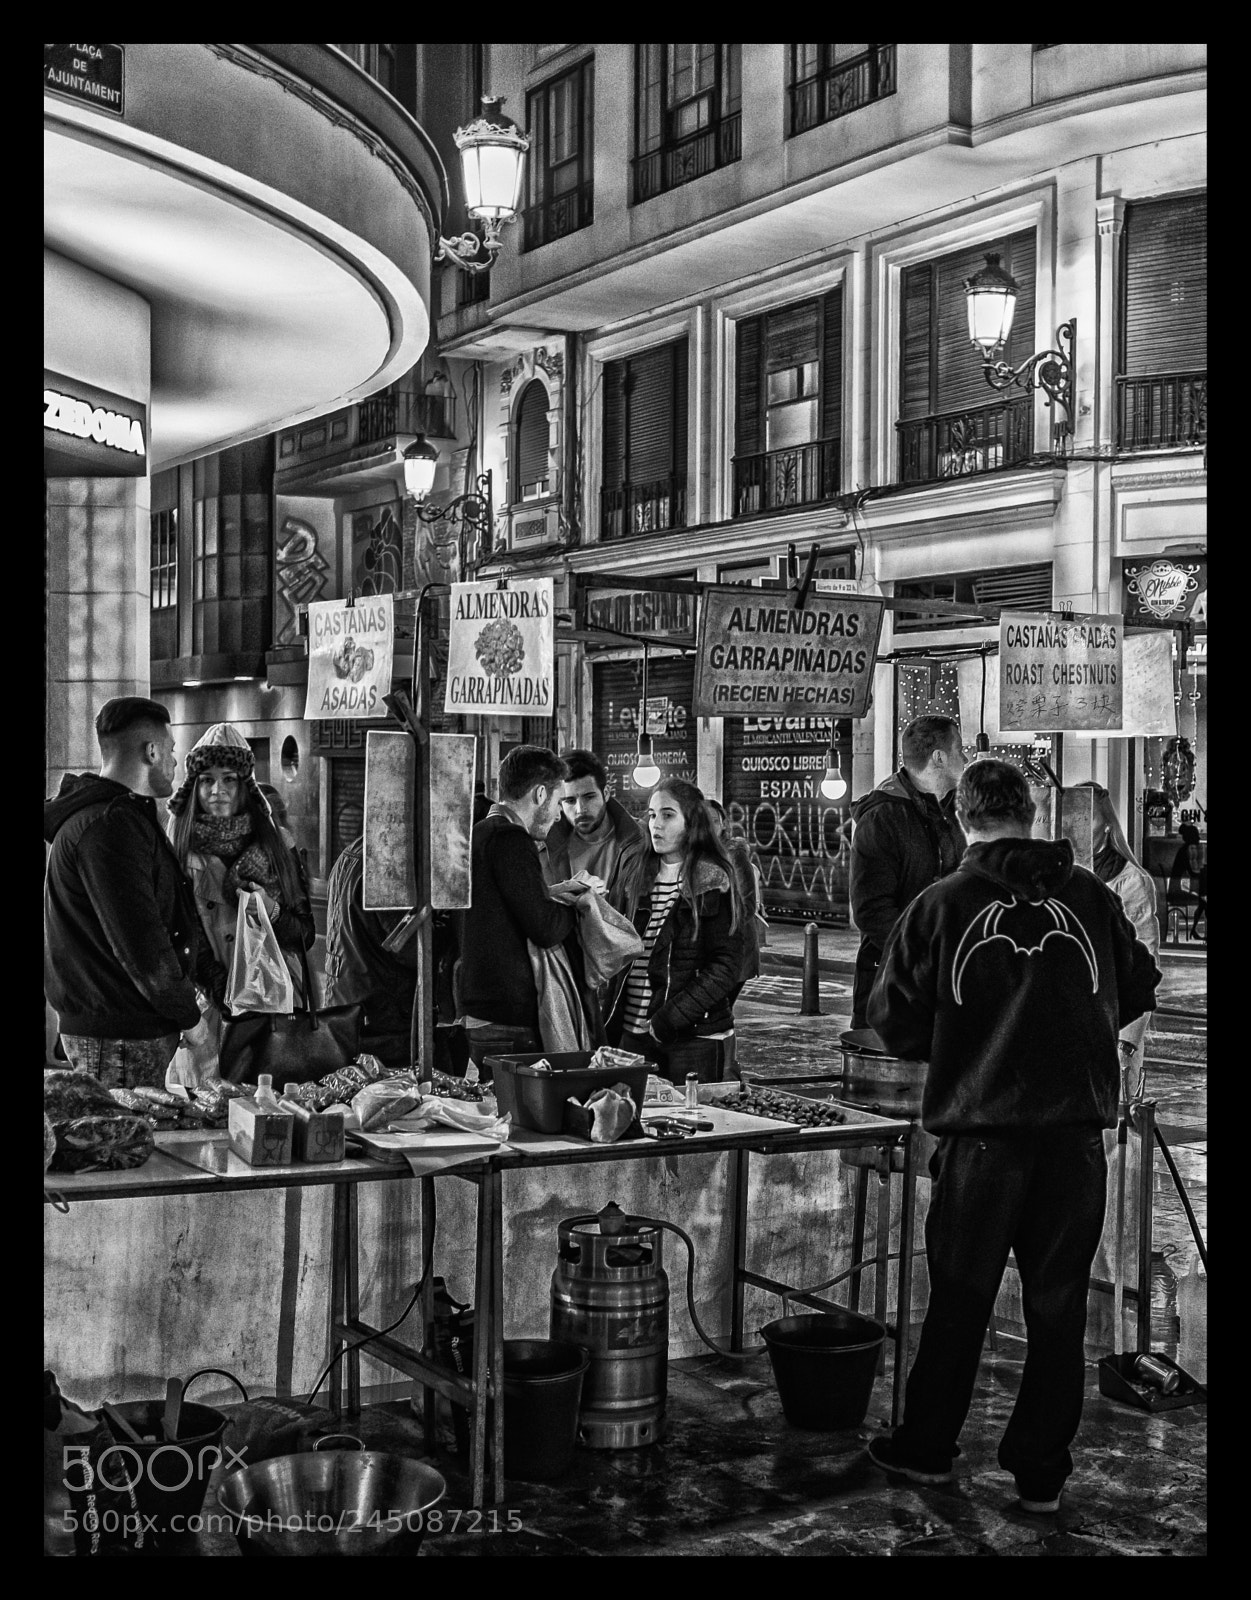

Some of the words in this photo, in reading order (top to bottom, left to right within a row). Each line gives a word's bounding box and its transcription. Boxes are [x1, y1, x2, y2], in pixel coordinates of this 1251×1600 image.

[73, 58, 87, 72] DE
[455, 590, 549, 620] ALMENDRAS
[315, 603, 386, 637] CASTAÑAS
[727, 607, 859, 637] ALMENDRAS
[1007, 621, 1067, 648] CASTAÑAS
[1072, 626, 1116, 649] SADAS
[709, 642, 867, 674] GARRAPIÑADAS
[1006, 664, 1044, 685] ROAST
[1053, 664, 1117, 685] CHESTNUTS
[320, 685, 378, 711] ASADAS
[712, 685, 780, 704] (RECIEN
[783, 687, 855, 707] HECHAS)
[608, 702, 687, 729] Levte
[741, 756, 790, 771] QUIOSCO
[760, 775, 821, 798] ESPAÑ
[1181, 809, 1201, 822] GIN
